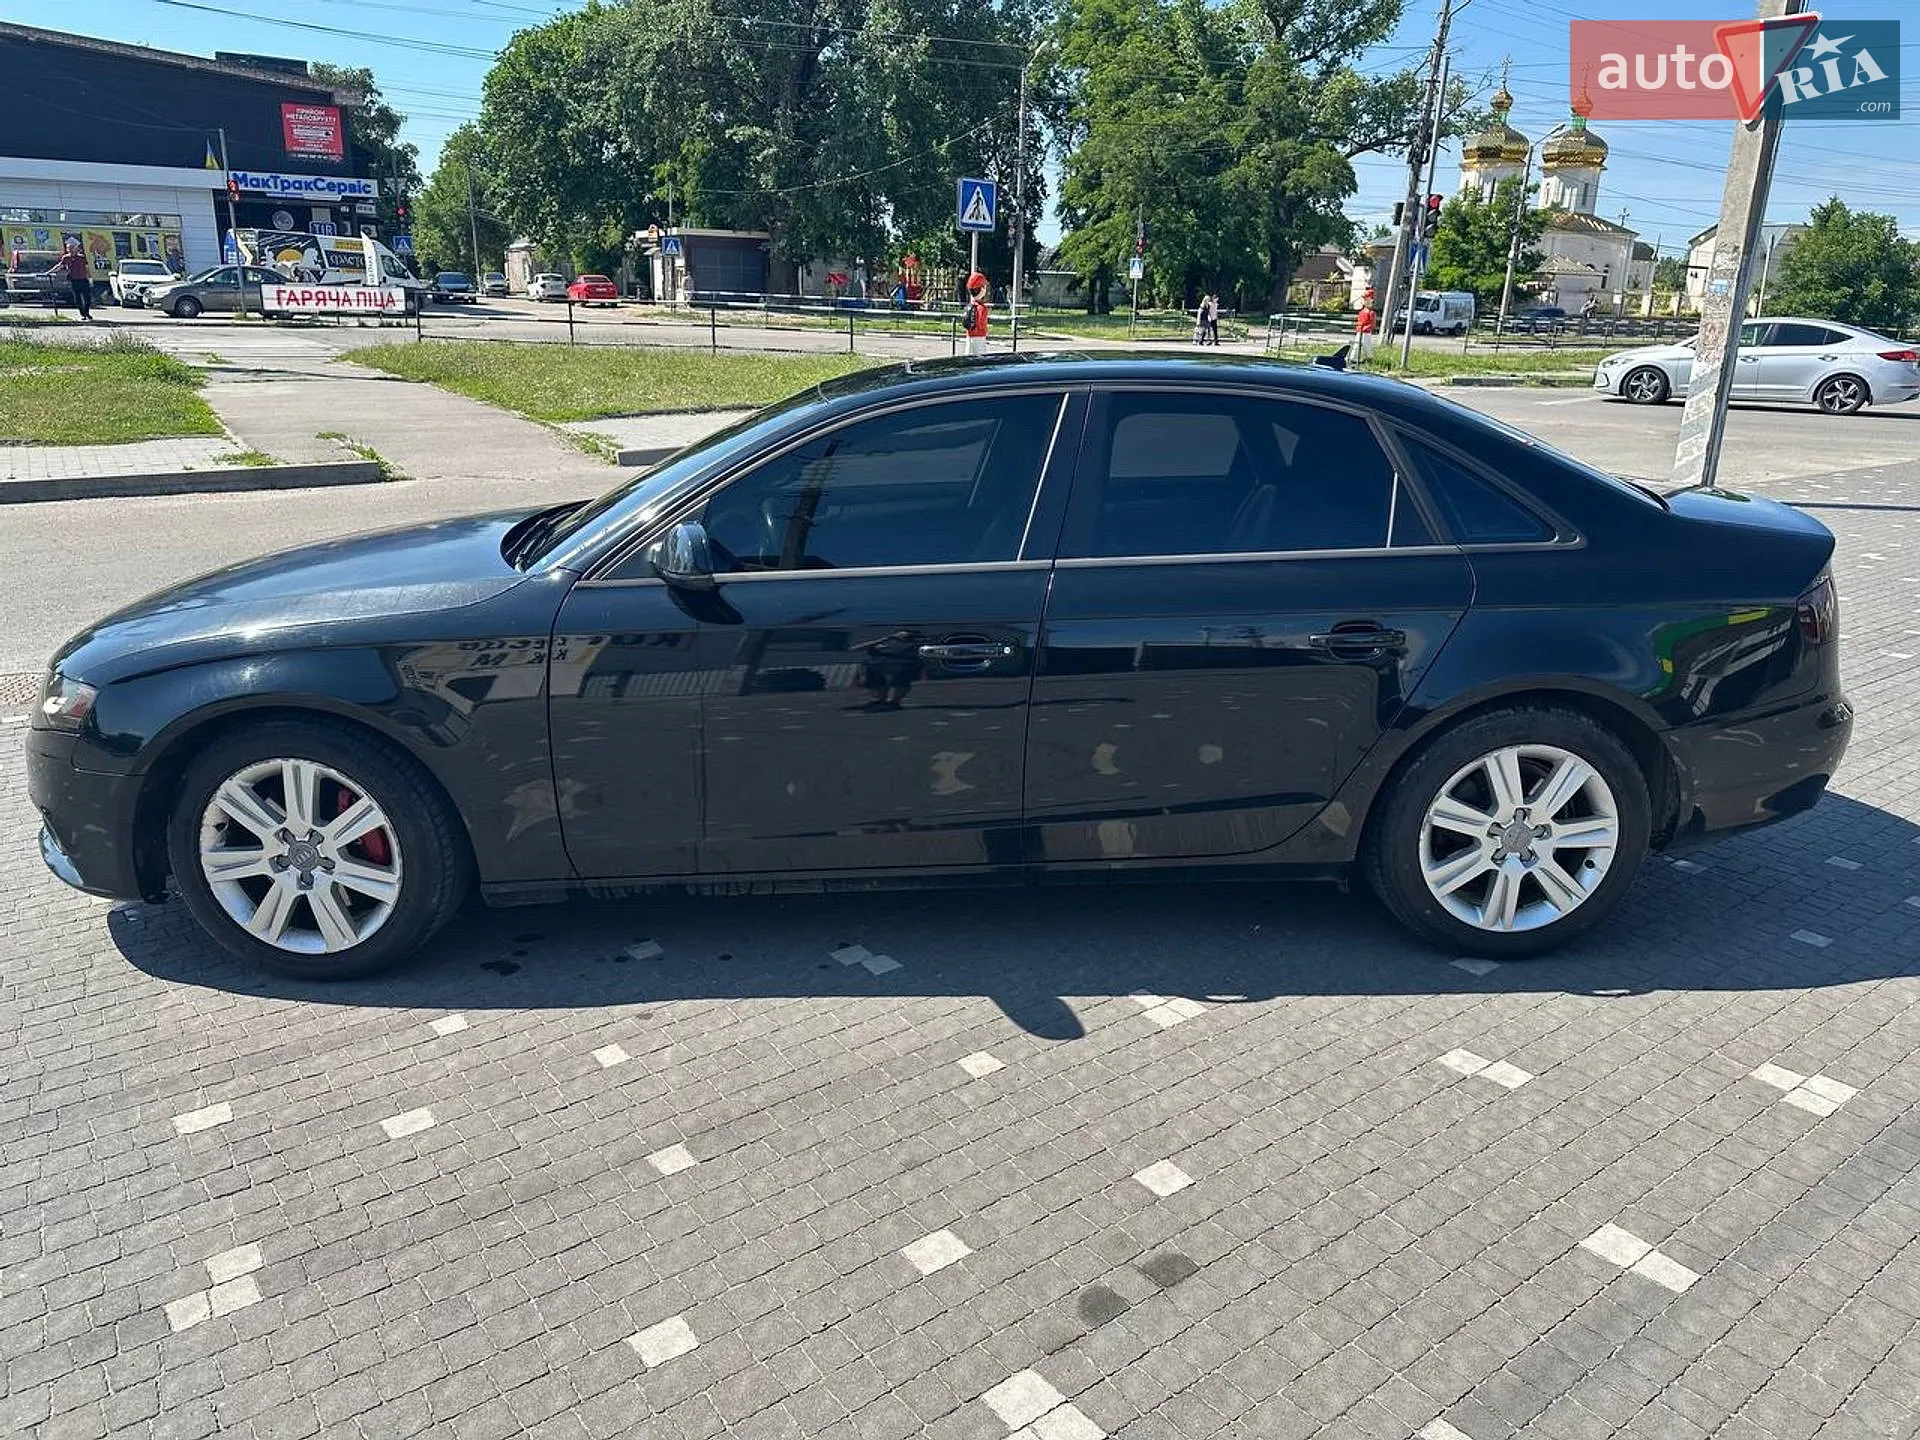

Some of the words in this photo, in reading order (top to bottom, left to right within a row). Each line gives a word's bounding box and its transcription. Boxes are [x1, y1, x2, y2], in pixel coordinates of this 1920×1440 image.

[232, 172, 372, 194] МакТракСервіс
[276, 289, 353, 307] ГАРЯЧА
[356, 291, 396, 308] ПІЦА
